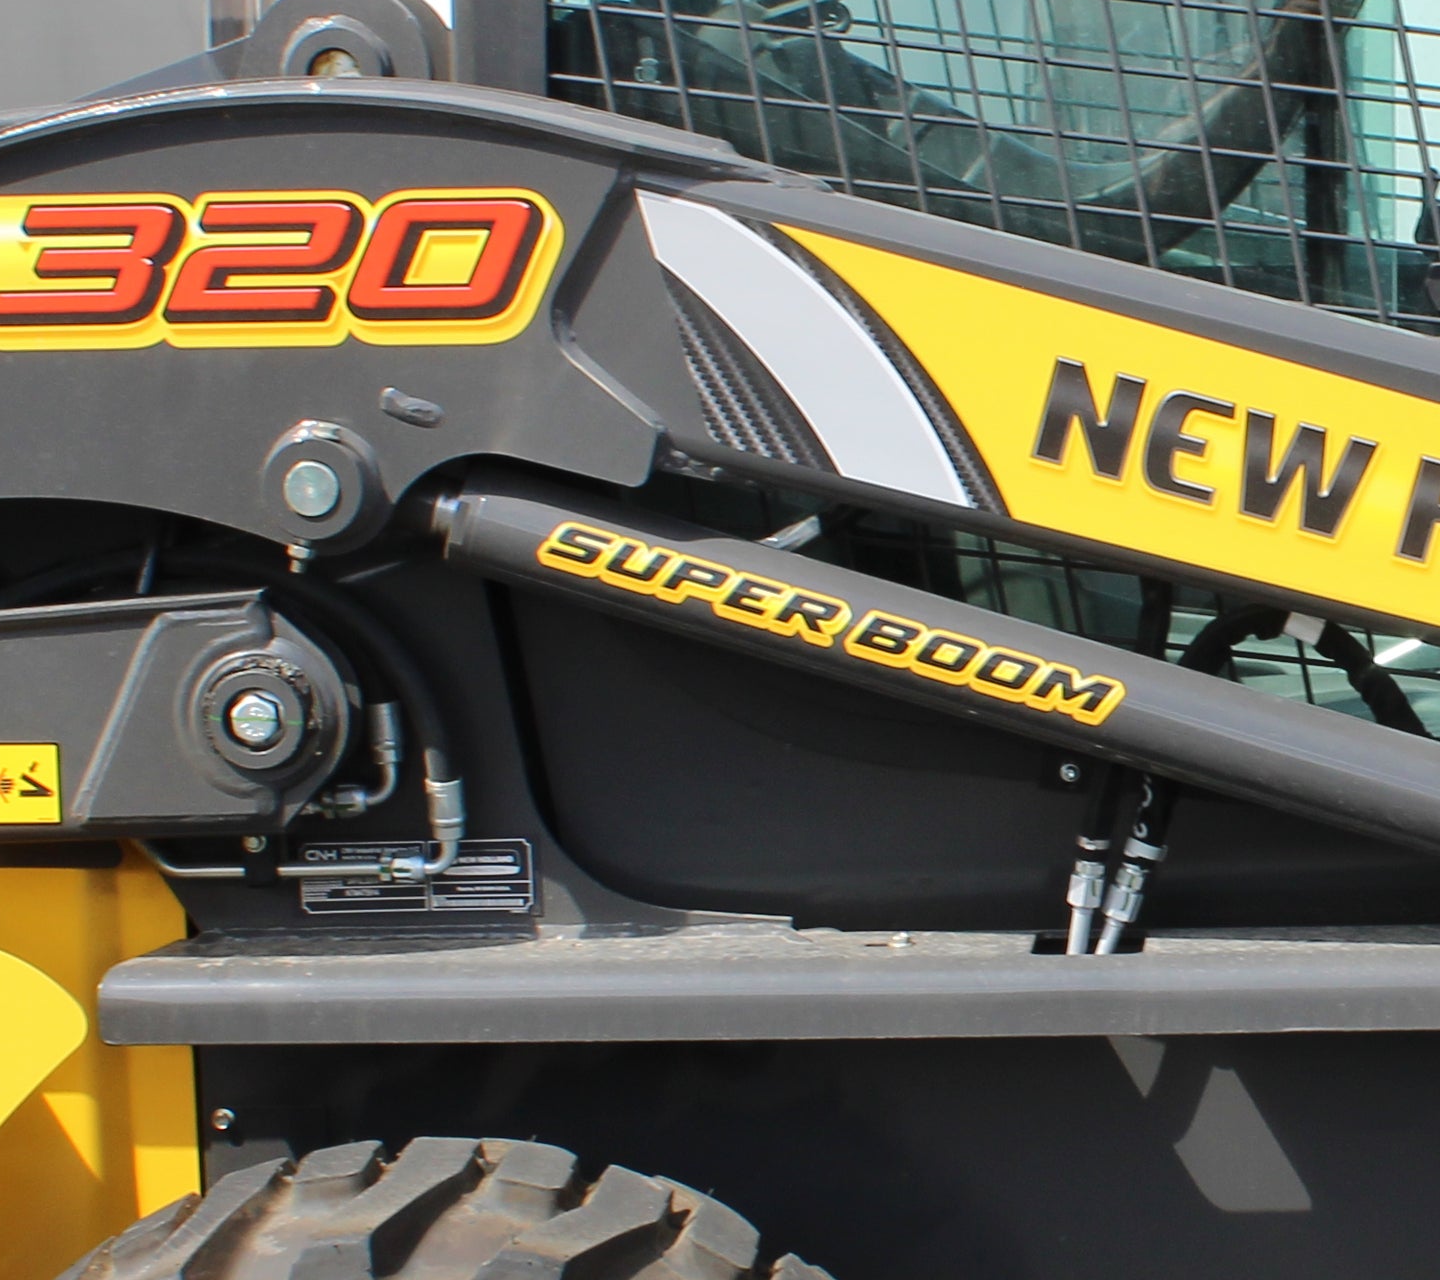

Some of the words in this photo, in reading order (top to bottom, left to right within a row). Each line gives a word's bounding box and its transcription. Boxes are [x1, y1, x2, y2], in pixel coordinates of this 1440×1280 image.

[1031, 356, 1378, 538] NEW
[541, 524, 848, 642] SUPER
[847, 610, 1123, 723] BOOM
[304, 849, 338, 862] CNH
